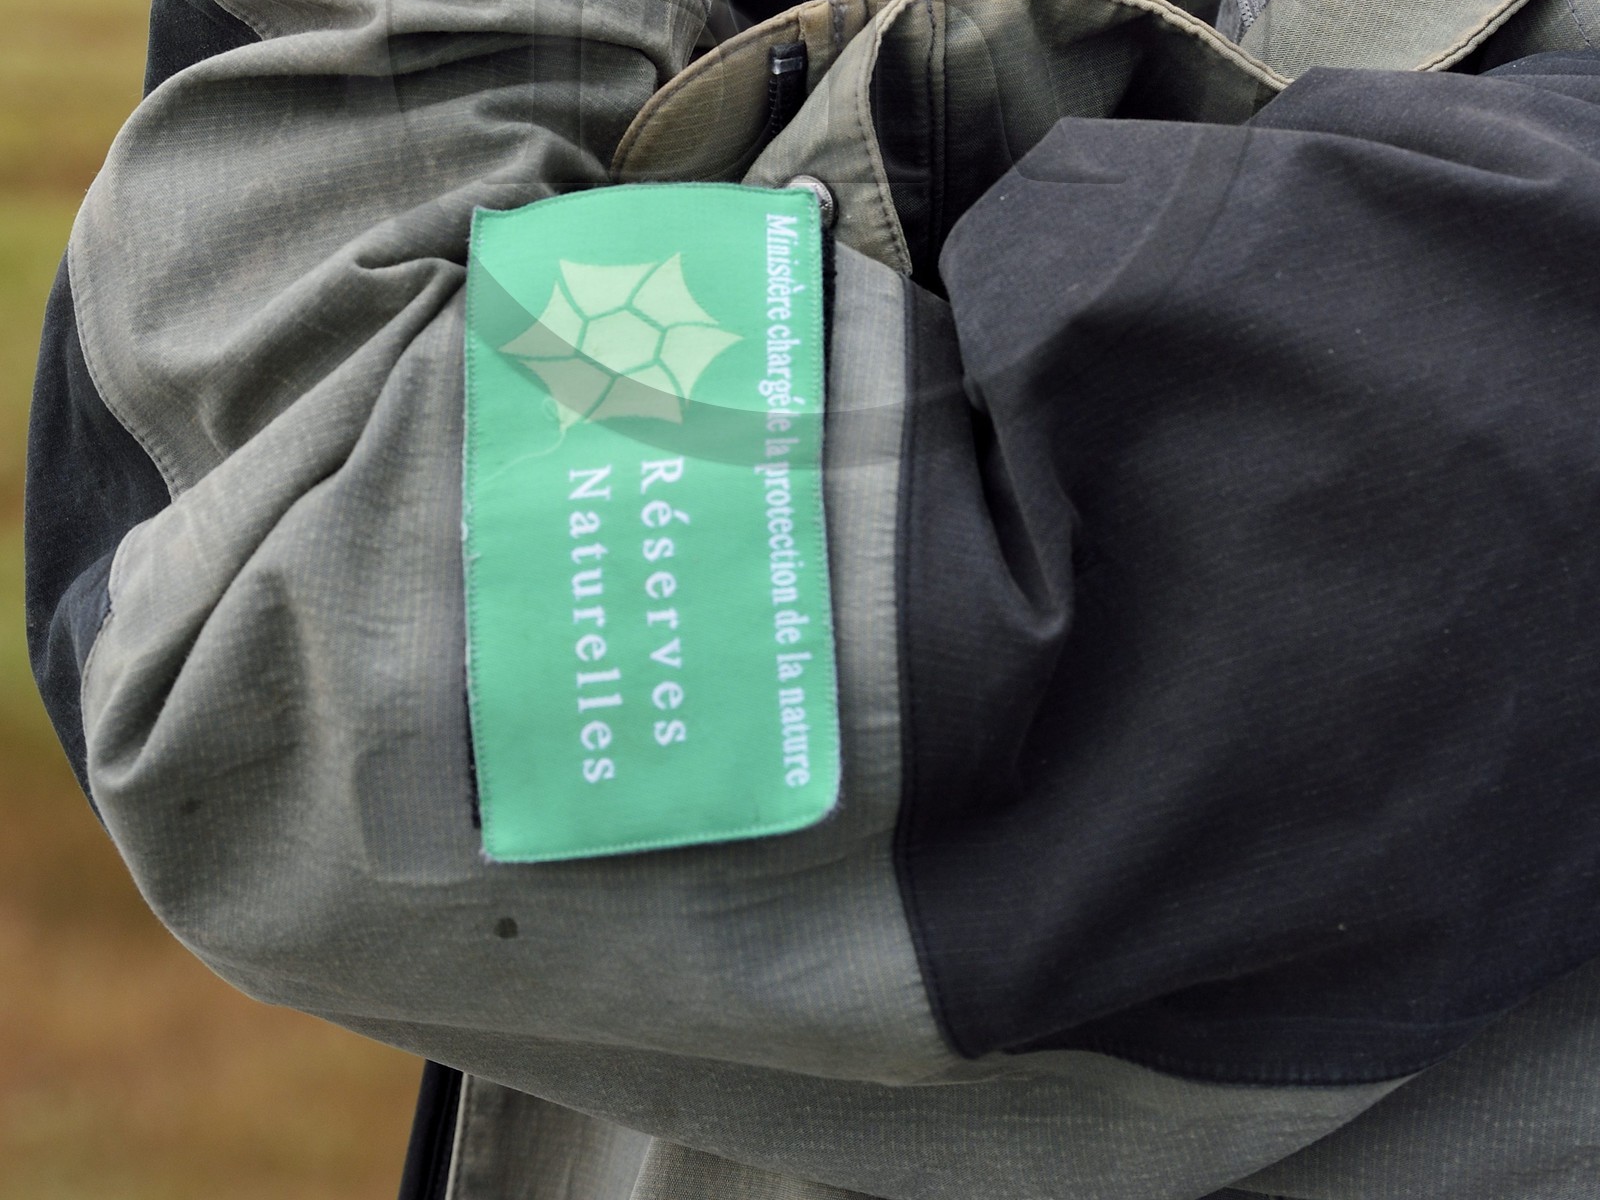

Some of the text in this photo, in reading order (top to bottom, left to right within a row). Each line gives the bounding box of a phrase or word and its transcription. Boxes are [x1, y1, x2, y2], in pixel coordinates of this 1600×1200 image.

[765, 213, 805, 321] Ministère
[757, 323, 805, 406] chargé
[764, 437, 800, 458] la
[753, 460, 804, 605] protection
[567, 463, 623, 783] Naturelles
[639, 455, 690, 746] Réserves
[773, 608, 811, 645] de
[776, 650, 812, 682] la
[778, 685, 812, 788] nature
